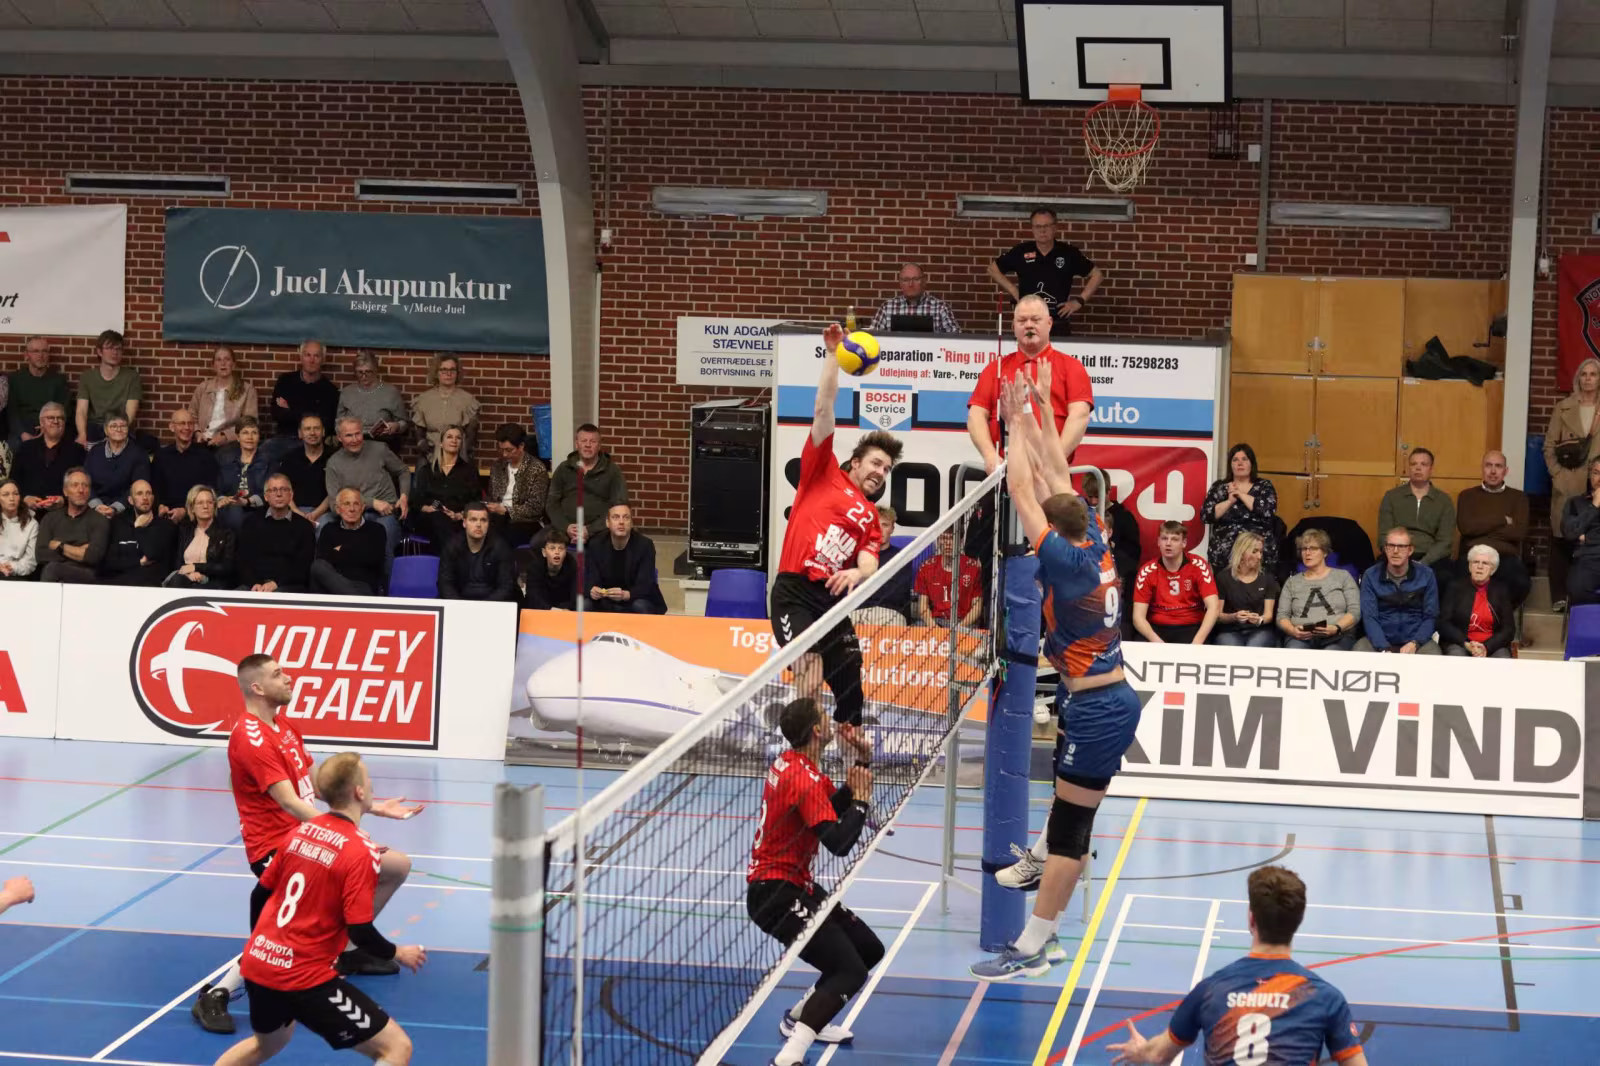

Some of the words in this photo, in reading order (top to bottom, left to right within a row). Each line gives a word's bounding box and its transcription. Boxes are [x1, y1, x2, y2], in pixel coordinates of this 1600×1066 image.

[270, 266, 327, 297] Juel
[333, 268, 512, 306] Akupunktur
[350, 301, 388, 314] Esbjerg
[403, 302, 442, 314] v/Mette
[445, 304, 466, 315] Juel
[704, 325, 729, 336] KUN
[700, 357, 767, 367] OVERTRÆDELSE
[880, 349, 934, 362] eparation
[974, 352, 985, 364] til
[1122, 356, 1179, 370] 75298283
[700, 367, 756, 378] BORTVISNING
[880, 368, 918, 379] Udlejning
[920, 369, 931, 379] af:
[1090, 376, 1114, 385] usser
[865, 392, 907, 404] BOSCH
[865, 404, 906, 414] Service
[845, 501, 875, 533] 22
[1169, 580, 1180, 596] 3
[1103, 586, 1119, 628] 9
[1299, 587, 1336, 619] A
[253, 624, 427, 673] VOLLEY
[880, 637, 951, 657] create
[861, 662, 949, 688] lutions
[1123, 659, 1400, 694] NTREPRENØR
[277, 675, 423, 724] GAEN
[290, 748, 303, 769] 3
[1068, 743, 1077, 754] 9
[277, 872, 305, 928] 8
[264, 939, 294, 957] TOYOTA
[266, 950, 293, 969] Lund
[1226, 992, 1290, 1009] SCHULTZ
[1232, 1012, 1271, 1066] 8
